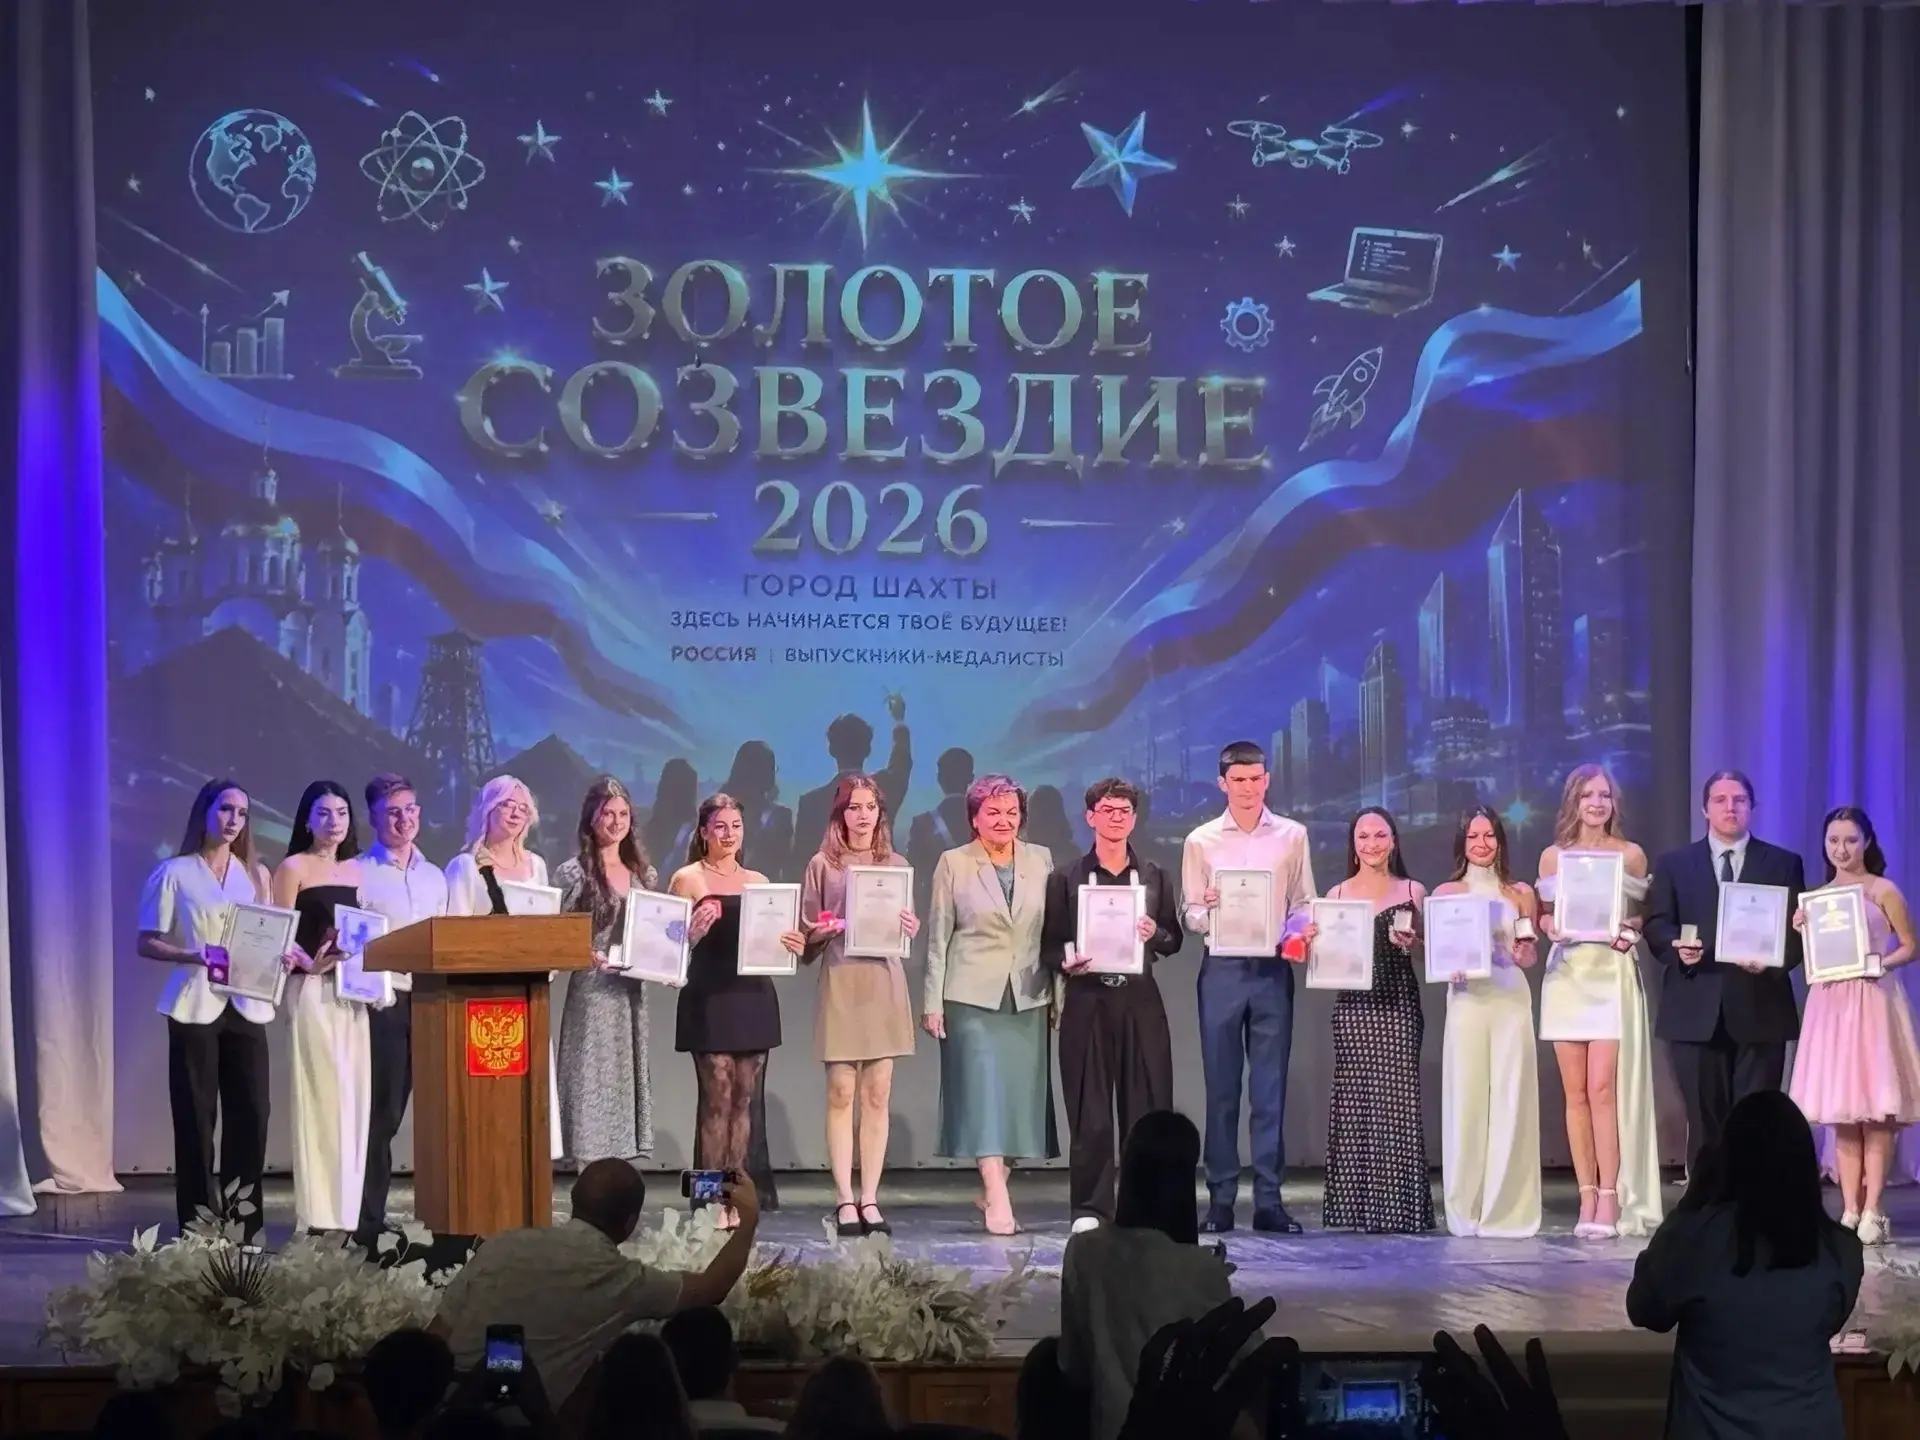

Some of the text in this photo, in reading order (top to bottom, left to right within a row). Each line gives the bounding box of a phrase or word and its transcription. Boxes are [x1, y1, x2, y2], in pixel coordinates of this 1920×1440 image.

[592, 256, 1153, 355] ЗОЛОТОЕ
[459, 359, 1272, 477] СОЗВЕЗДИЕ
[754, 480, 988, 556] 2026
[743, 573, 997, 601] ГОРОД ШАХТЫ
[670, 611, 1068, 634] ЗДЕСЬ НАЧИНАЕТСЯ ТВОЁ БУДУЩЕЕ!
[671, 646, 1065, 668] РОССИЯ ВЫПУСКНИКИ-МЕДАЛИСТЫ
